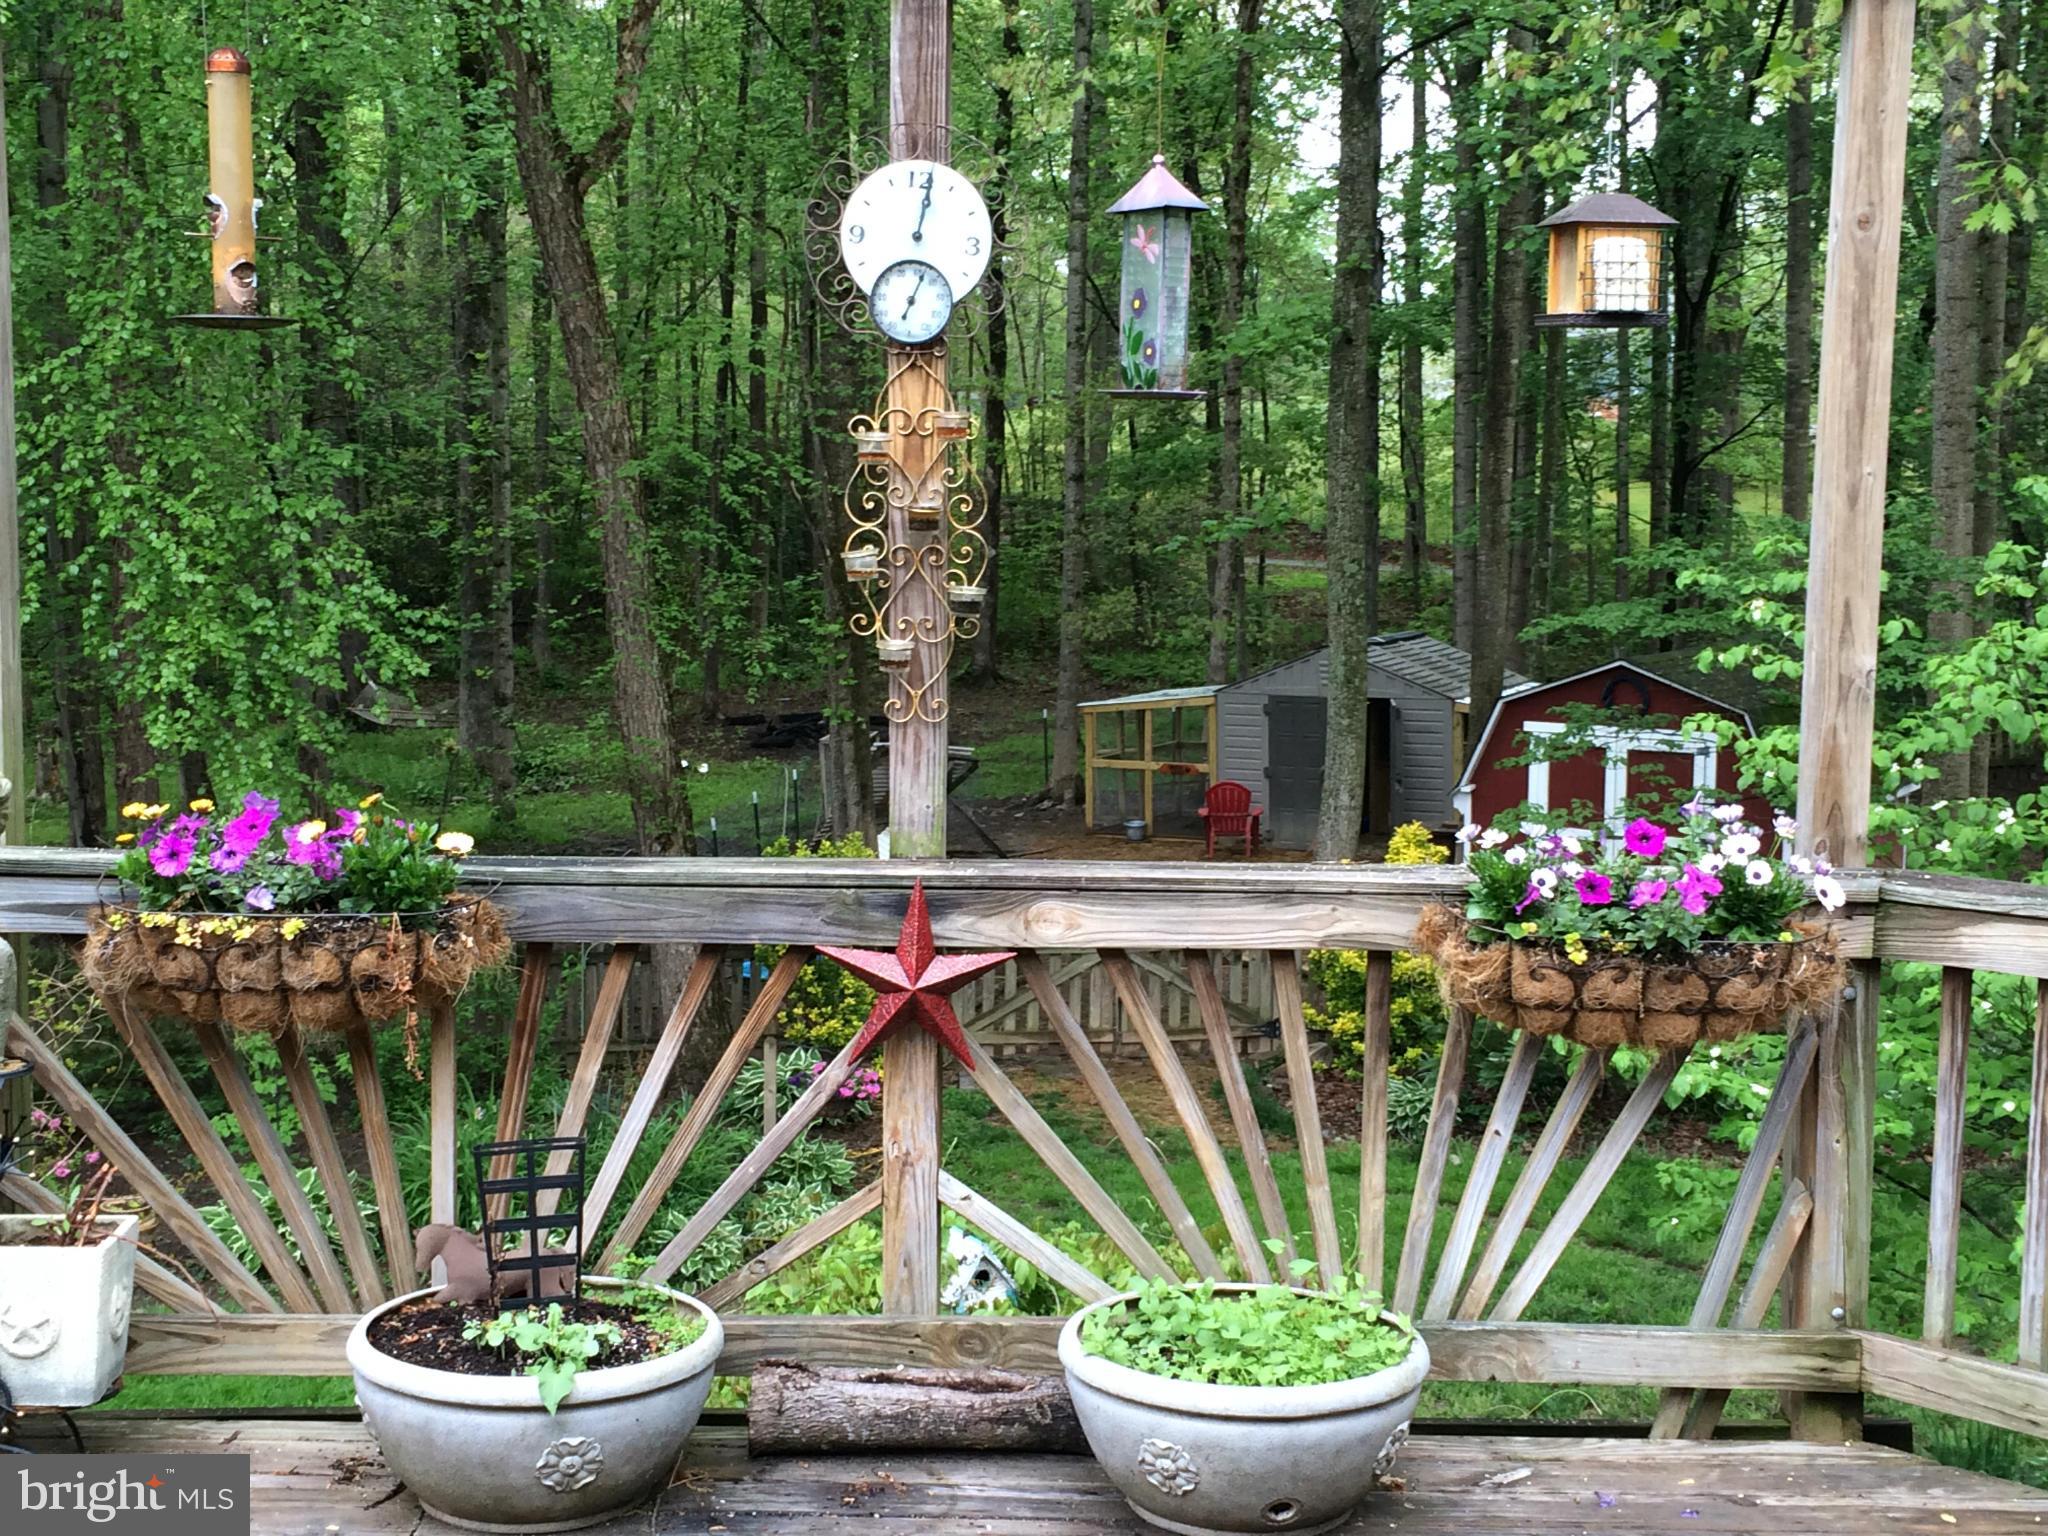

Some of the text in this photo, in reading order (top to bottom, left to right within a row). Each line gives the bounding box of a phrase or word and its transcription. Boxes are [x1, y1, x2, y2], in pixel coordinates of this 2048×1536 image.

[908, 170, 934, 190] 12
[848, 224, 866, 244] 9
[964, 236, 981, 257] 3
